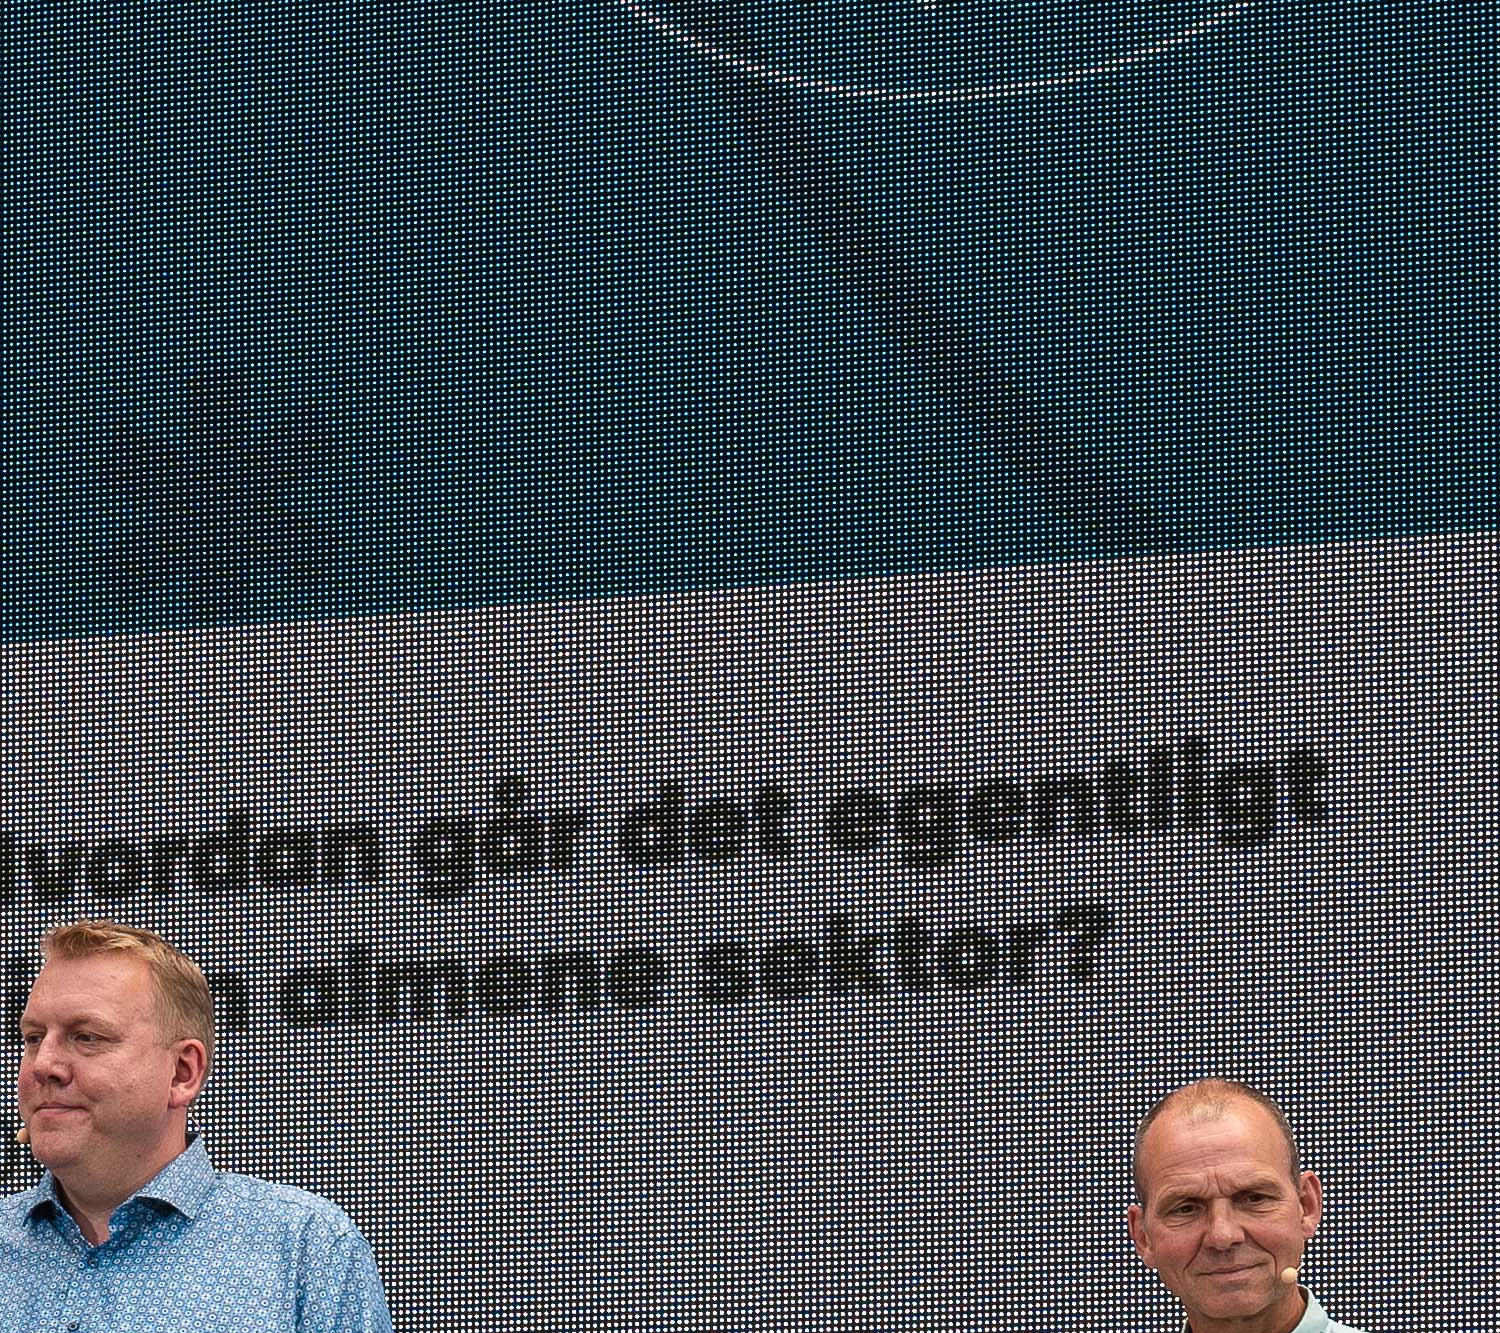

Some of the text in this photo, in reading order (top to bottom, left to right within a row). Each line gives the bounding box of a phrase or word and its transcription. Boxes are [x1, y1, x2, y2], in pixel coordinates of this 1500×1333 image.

[413, 775, 588, 900] går
[618, 781, 795, 867] det
[824, 733, 1328, 872] egentligt
[279, 944, 668, 1031] almene
[699, 903, 1112, 1007] sektor?
